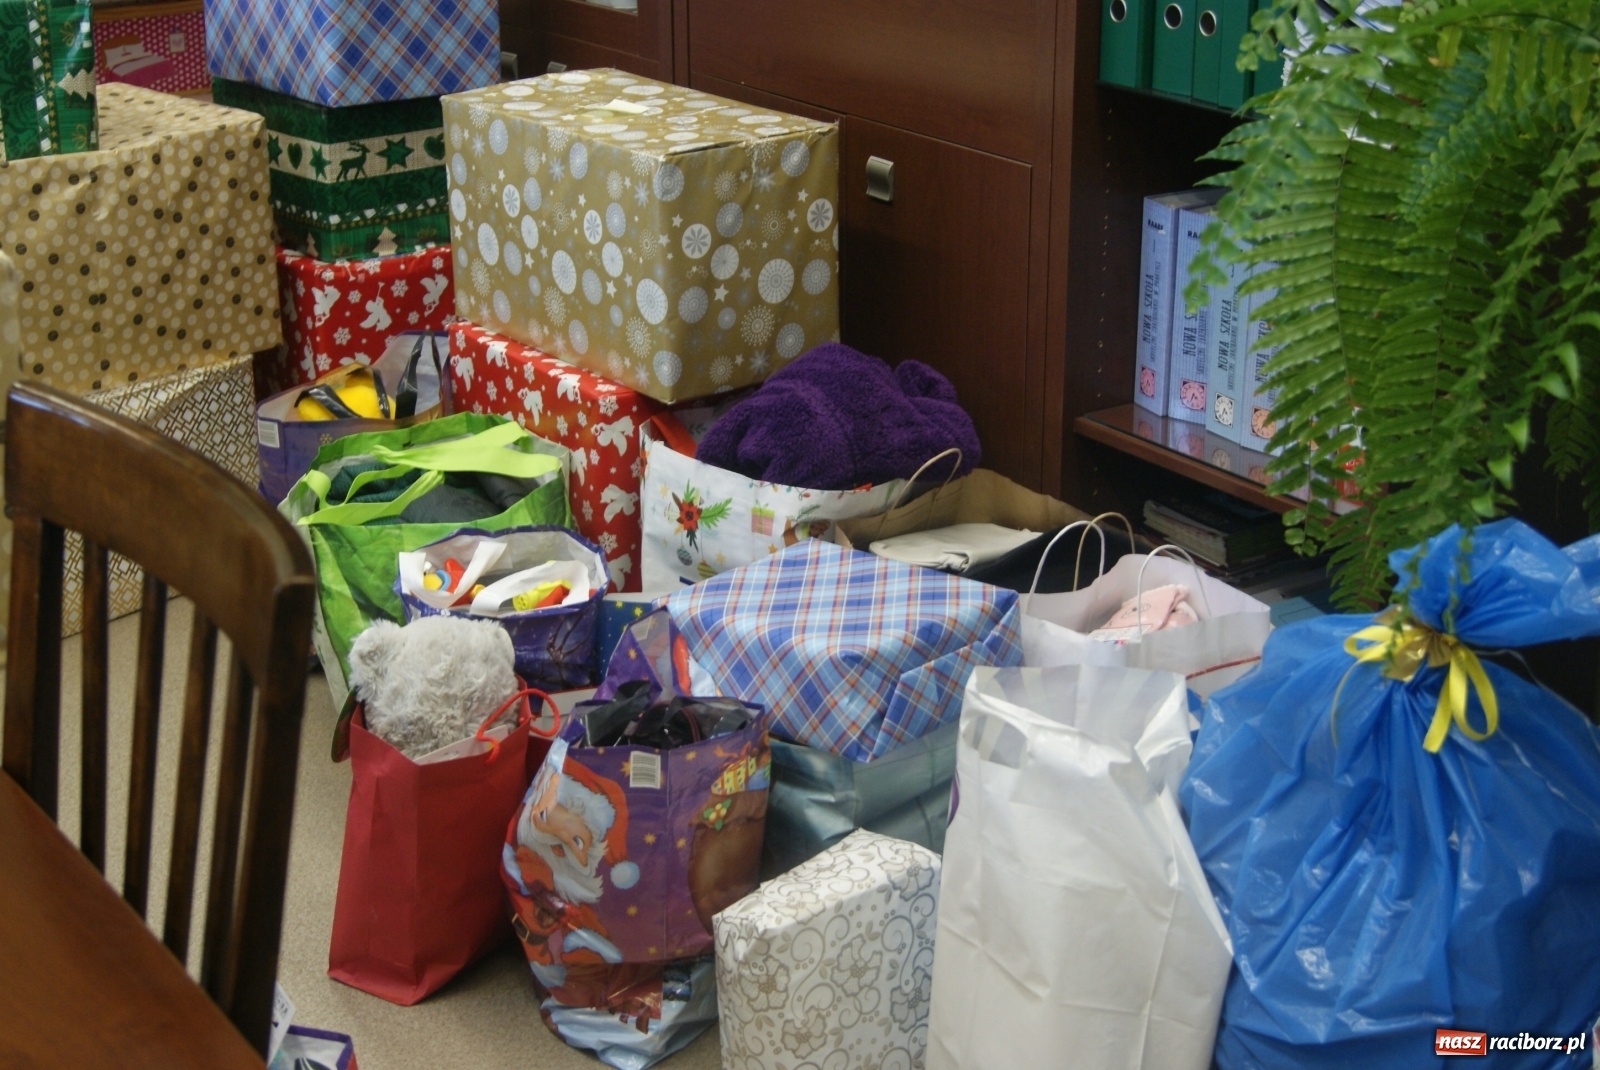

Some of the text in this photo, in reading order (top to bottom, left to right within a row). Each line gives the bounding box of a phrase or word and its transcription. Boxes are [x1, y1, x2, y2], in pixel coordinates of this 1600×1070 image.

[1142, 273, 1154, 344] NOWA SZKOŁA
[1183, 327, 1197, 357] NOWA
[1218, 299, 1232, 371] NOWA SZKOŁA
[1255, 353, 1270, 382] NOWA
